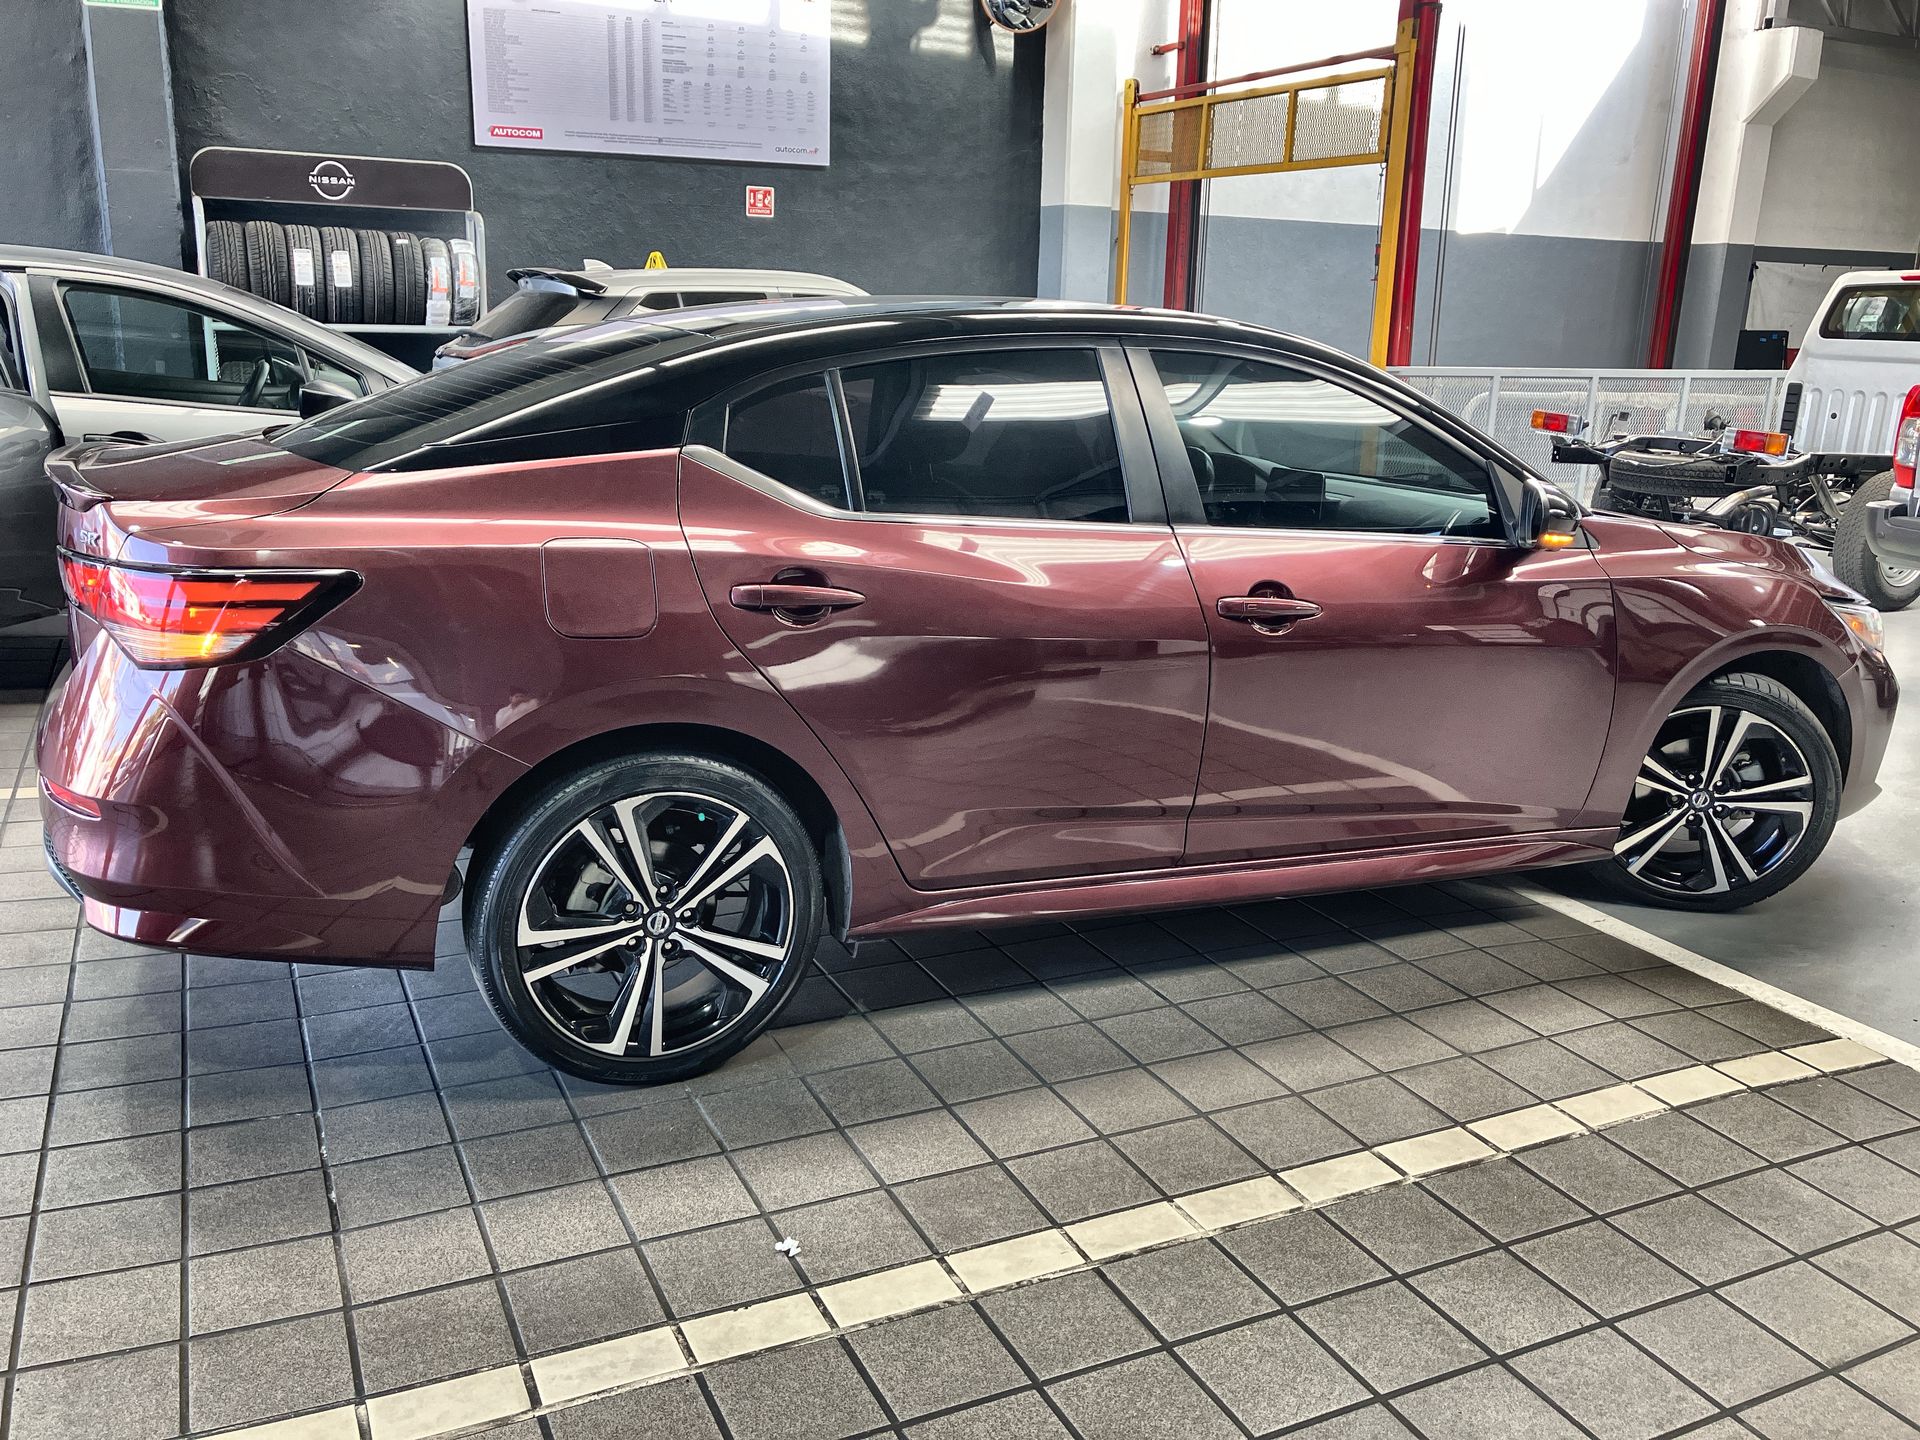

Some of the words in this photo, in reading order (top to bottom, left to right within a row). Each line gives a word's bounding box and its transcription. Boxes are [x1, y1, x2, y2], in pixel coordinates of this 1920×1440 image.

[493, 128, 541, 138] AUTOCOM
[308, 175, 355, 185] NISSAN
[80, 529, 98, 547] SR
